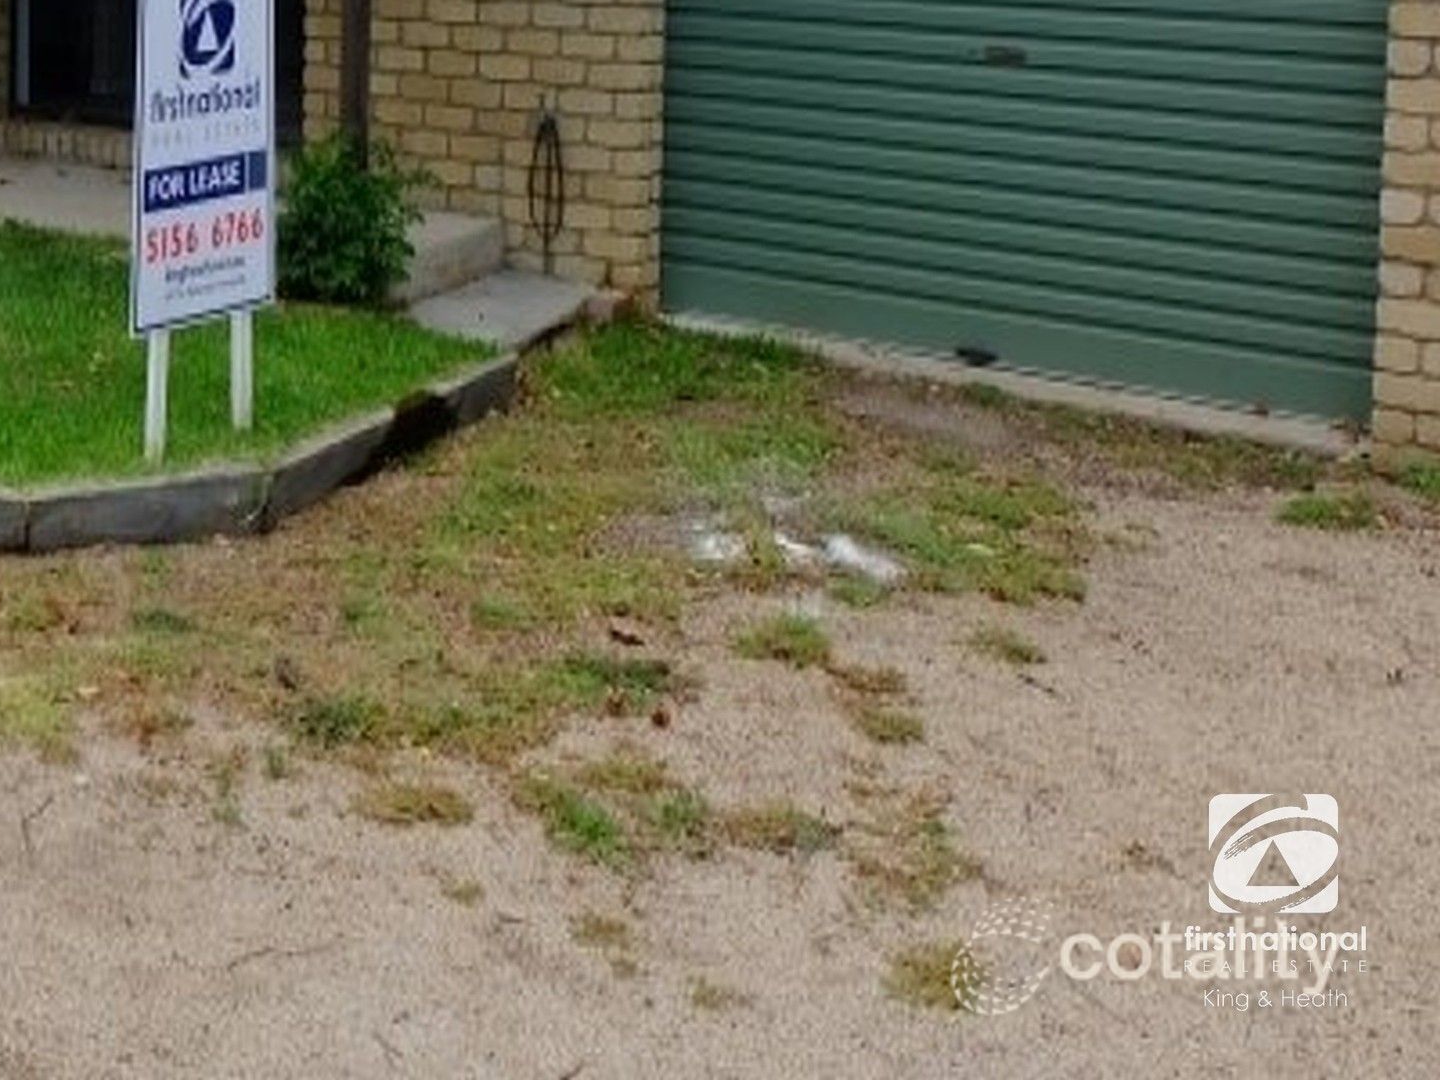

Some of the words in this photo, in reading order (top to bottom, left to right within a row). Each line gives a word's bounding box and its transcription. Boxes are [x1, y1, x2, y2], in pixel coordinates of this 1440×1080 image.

[148, 175, 185, 201] FOR
[189, 161, 241, 194] LEASE
[147, 223, 198, 263] 5156
[212, 208, 263, 248] 6766
